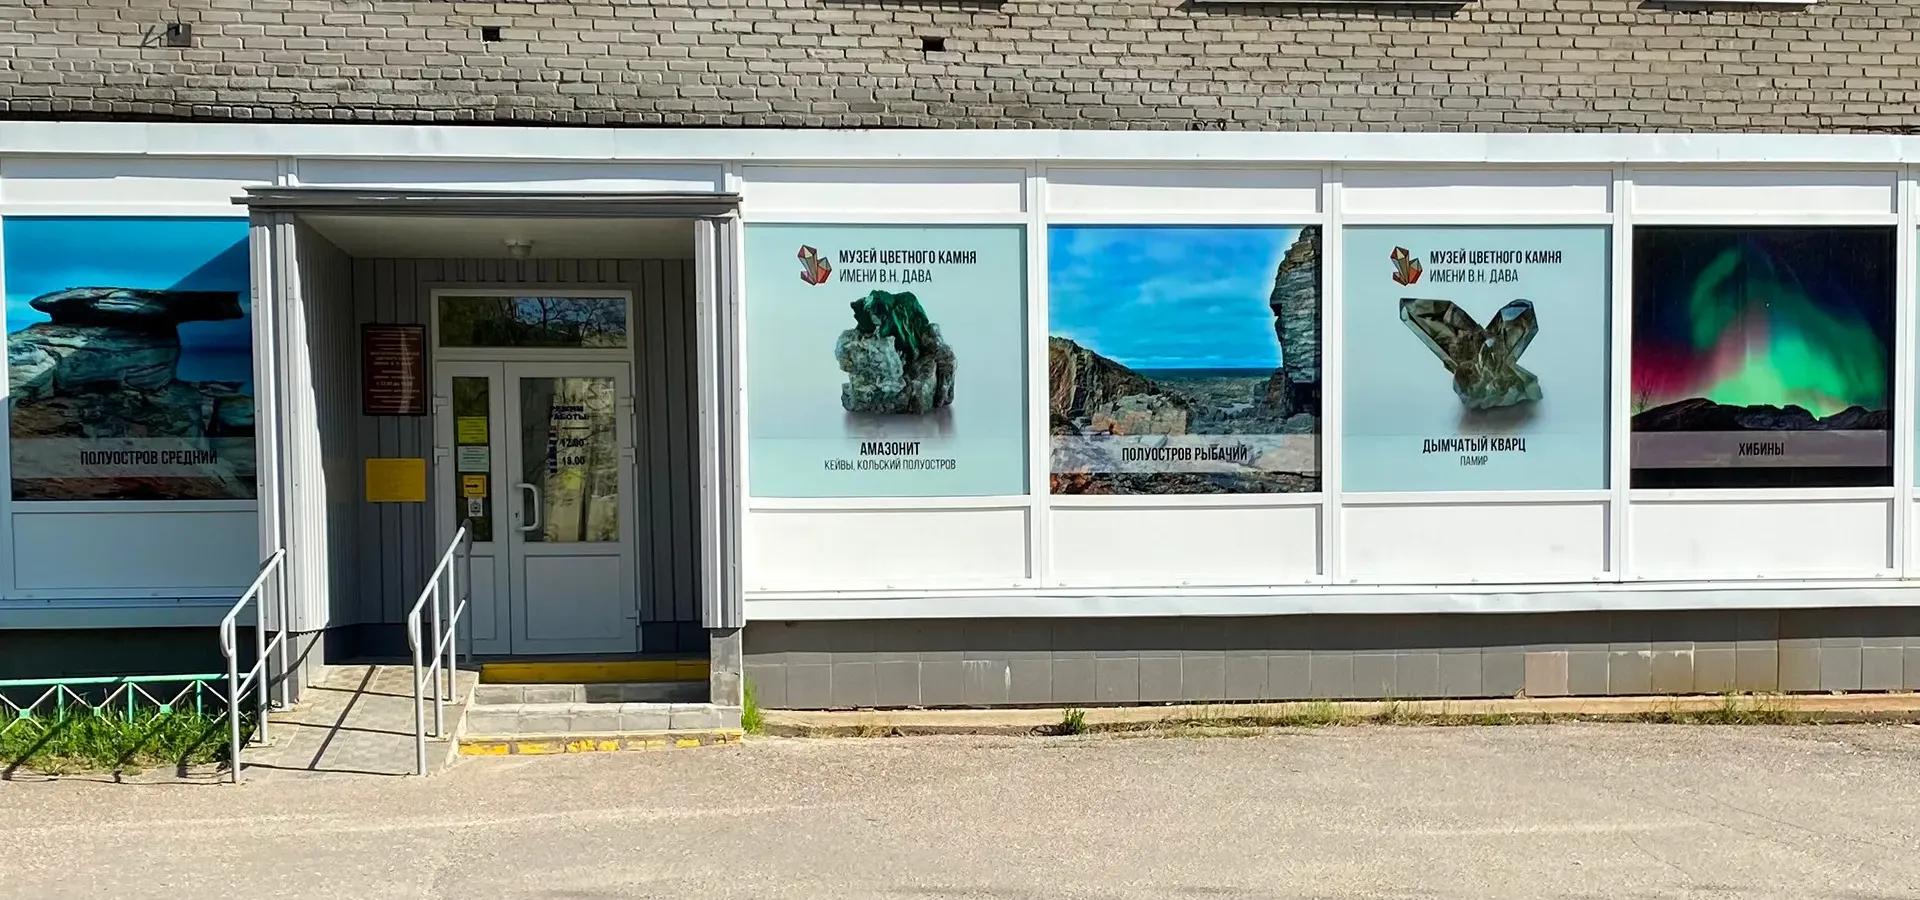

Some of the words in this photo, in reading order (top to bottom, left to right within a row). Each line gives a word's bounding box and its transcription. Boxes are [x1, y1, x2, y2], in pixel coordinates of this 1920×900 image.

[839, 248, 876, 264] МУЗЕЙ
[880, 250, 936, 265] ЦВЕТНОГО
[938, 251, 977, 264] КАМНЯ
[1430, 248, 1466, 264] МУЗЕЙ
[1469, 250, 1523, 265] ЦВЕТНОГО
[1525, 250, 1562, 264] КАМНЯ
[839, 269, 877, 283] ИМЕНИ
[902, 269, 932, 284] ДАВА
[1430, 269, 1466, 283] ИМЕНИ
[1489, 269, 1518, 284] ДАВА
[860, 442, 921, 456] АМАЗОНИТ
[1423, 436, 1488, 453] ДЫМЧАТЫЙ
[1490, 438, 1526, 452] КВАРЦ
[1738, 442, 1784, 456] ХИБИНЫ
[80, 451, 157, 465] ПОЛУОСТРОВ
[1122, 448, 1191, 461] ПОЛУОСТРОВ
[1194, 445, 1247, 461] РЫБАЧИЙ
[1460, 455, 1488, 466] ПАМИР
[824, 458, 855, 471] КЕЙВЫ,
[857, 458, 900, 470] КОЛЬСКИЙ
[903, 459, 956, 470] ПОЛУОСТРОВ
